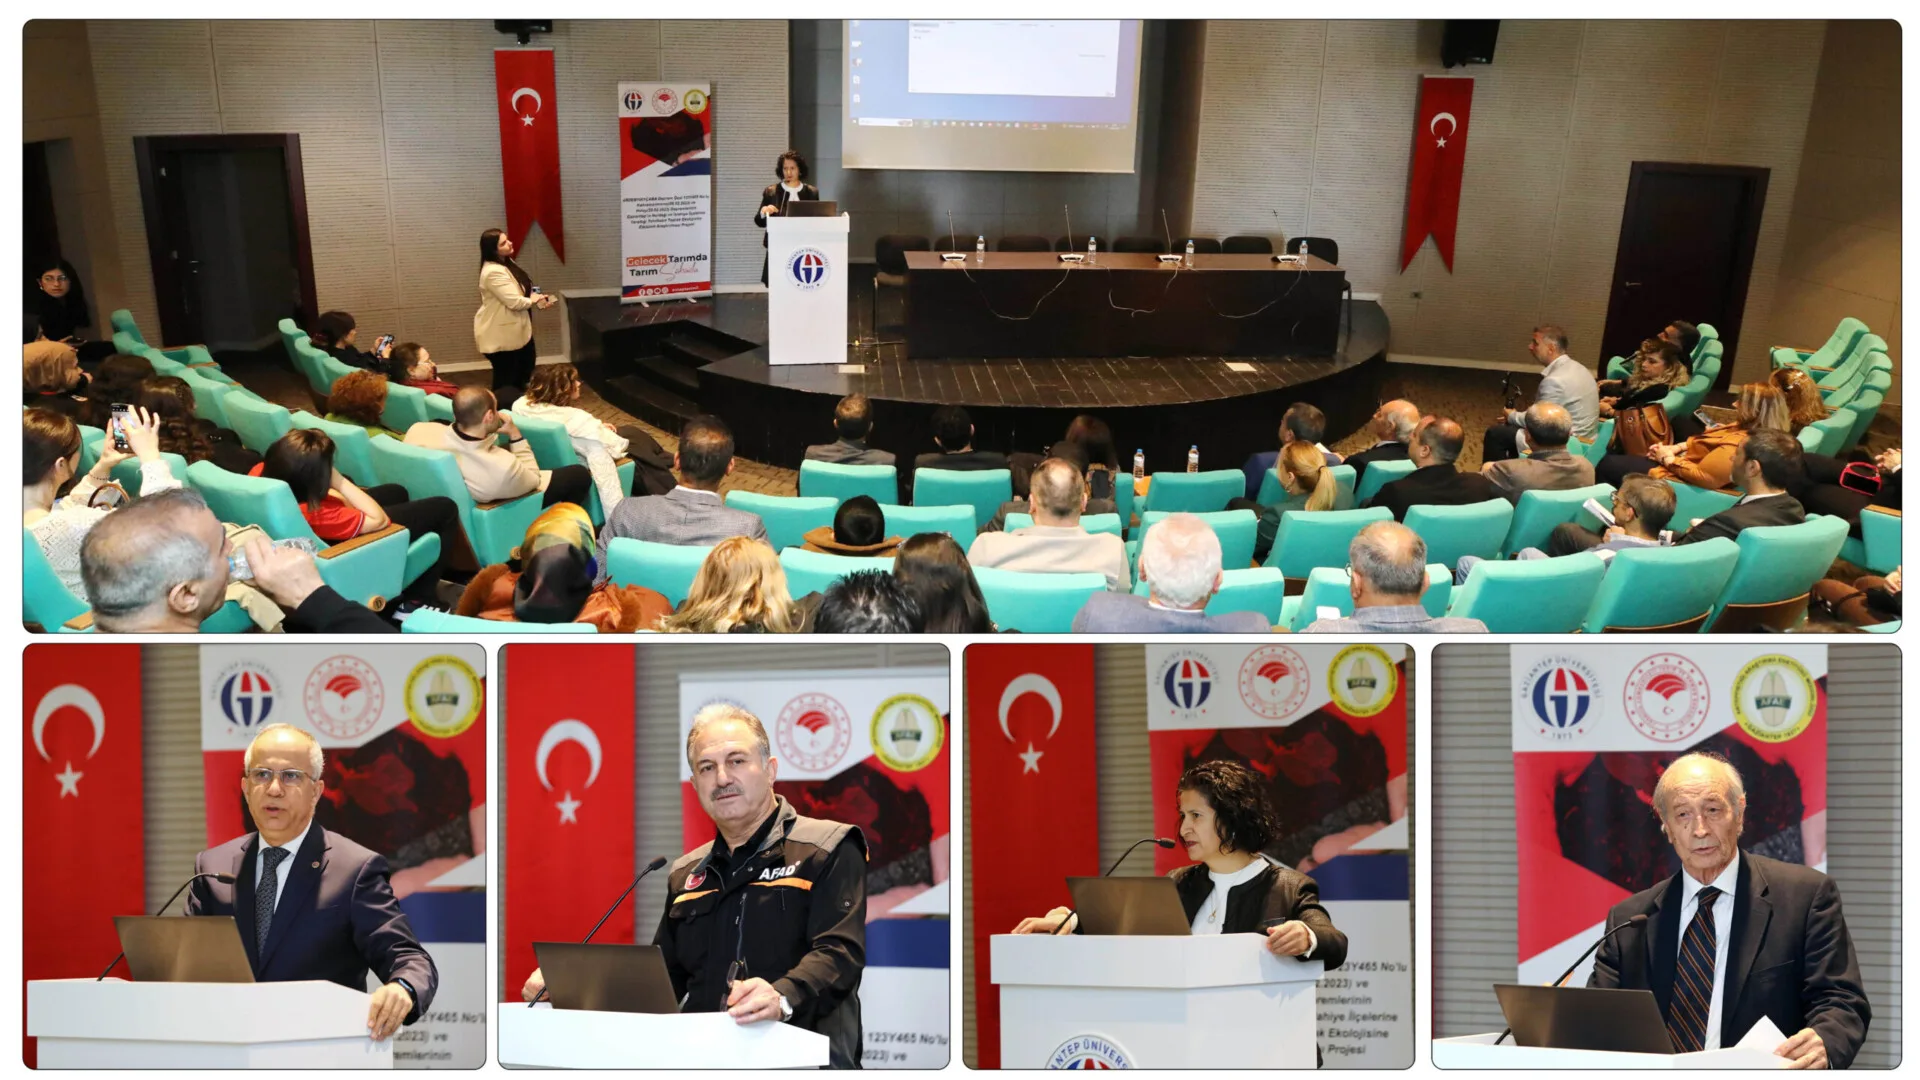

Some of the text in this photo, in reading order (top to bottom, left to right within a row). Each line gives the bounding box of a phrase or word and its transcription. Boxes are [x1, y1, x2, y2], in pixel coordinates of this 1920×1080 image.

[627, 254, 708, 266] Gelecek Tarımda
[629, 269, 658, 277] Tarım
[758, 864, 797, 881] AFAD
[1337, 962, 1378, 972] 23Y465
[1316, 994, 1373, 1004] remlerinin
[1316, 1012, 1346, 1024] ahiye
[434, 1034, 448, 1042] ve
[868, 1032, 916, 1044] 123Y465
[1328, 1028, 1389, 1041] Ekolojisine
[1083, 1038, 1129, 1069] ÜNİVERS
[1327, 1044, 1367, 1056] Projesi
[892, 1053, 907, 1061] ve
